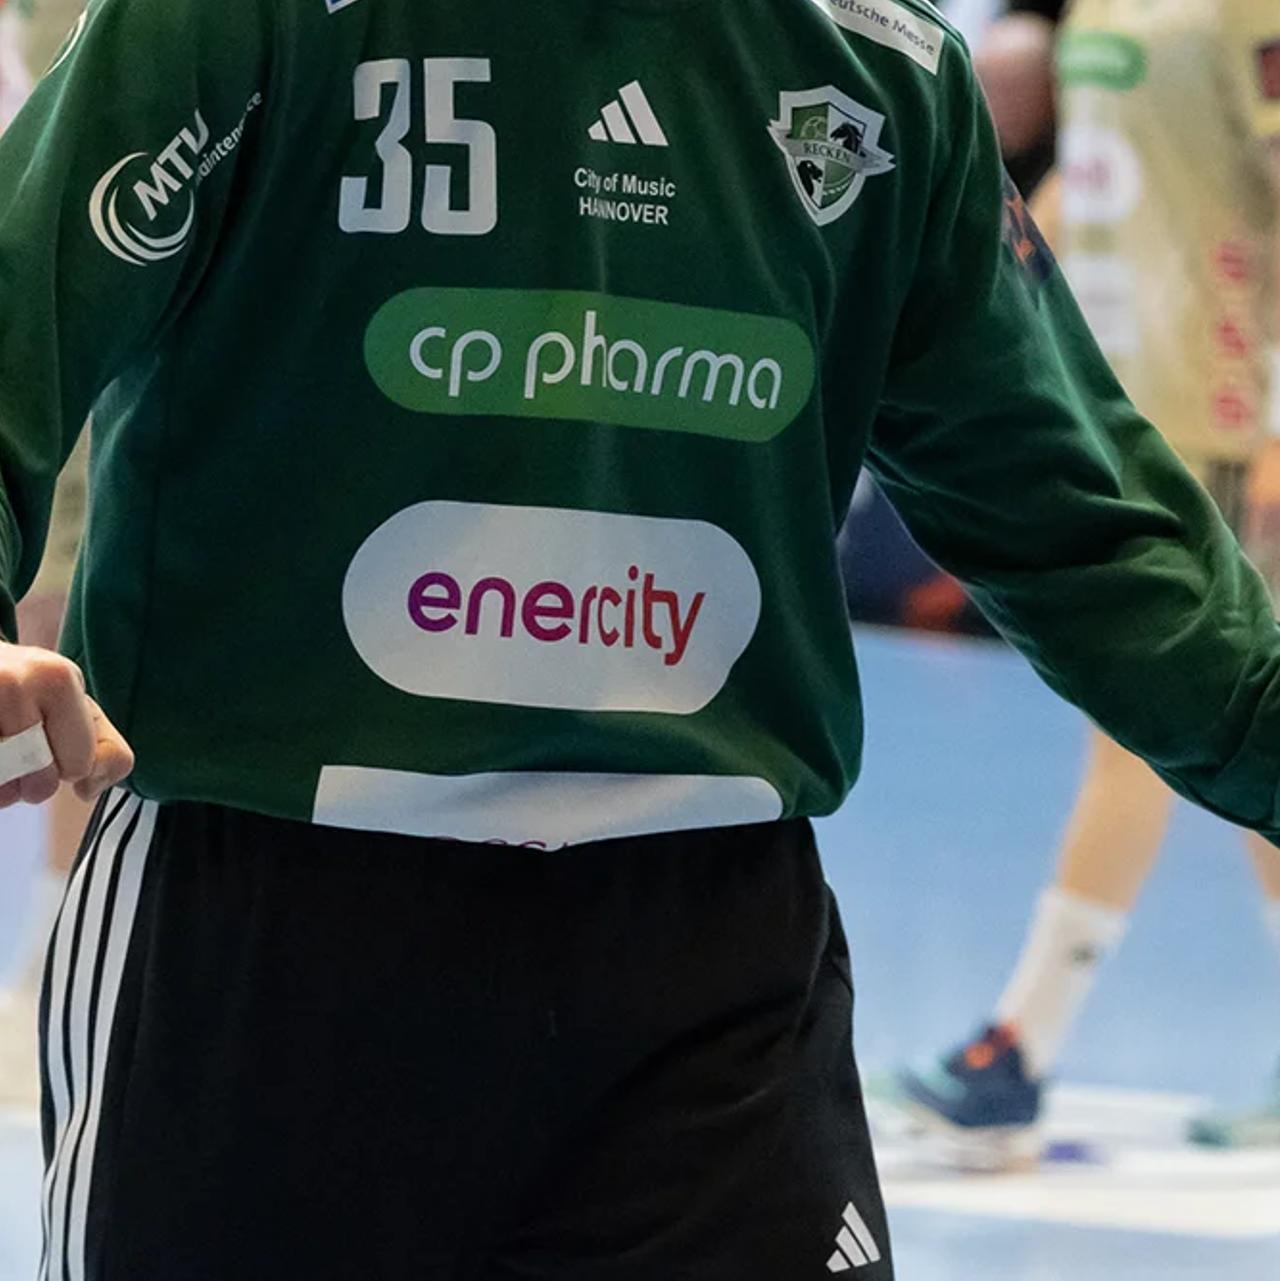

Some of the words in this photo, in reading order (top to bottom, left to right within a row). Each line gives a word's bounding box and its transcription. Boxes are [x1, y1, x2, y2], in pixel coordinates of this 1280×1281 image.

[892, 19, 936, 57] Messe
[338, 56, 498, 236] 35
[803, 141, 851, 164] RECKEN
[573, 167, 602, 195] City
[603, 173, 619, 193] of
[622, 173, 677, 199] Music
[579, 196, 669, 226] HANNOVER
[409, 326, 503, 398] cp
[524, 310, 783, 410] pharma
[407, 565, 707, 667] enercity
